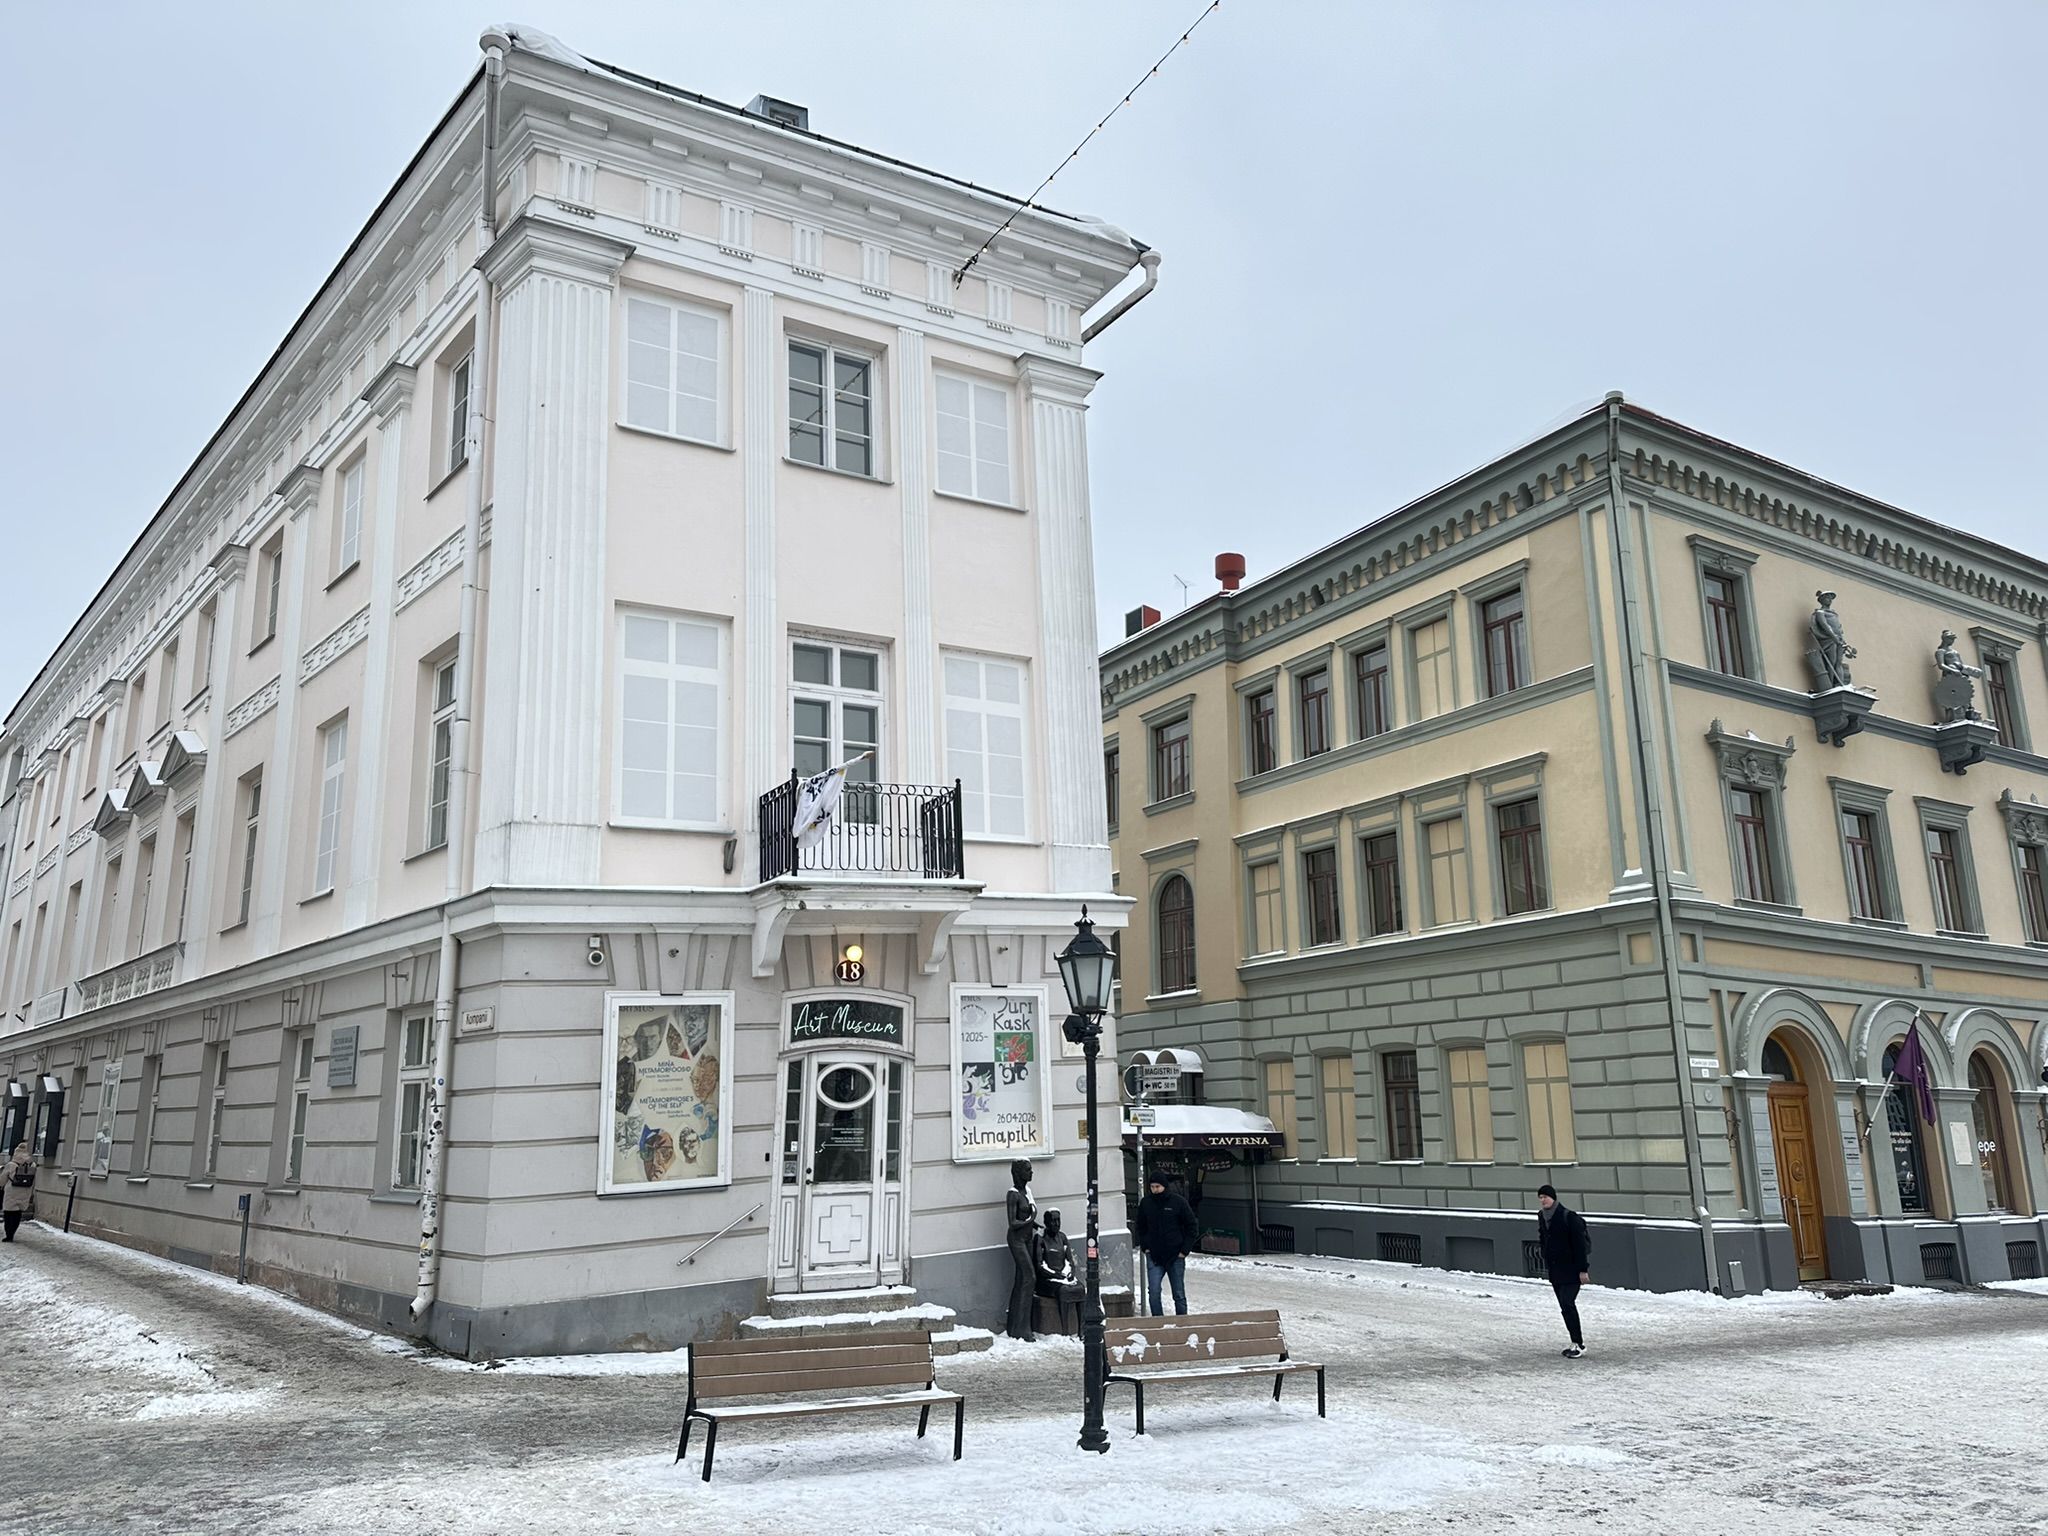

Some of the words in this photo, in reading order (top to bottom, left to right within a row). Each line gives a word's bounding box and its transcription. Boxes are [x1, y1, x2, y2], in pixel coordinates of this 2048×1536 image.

[840, 962, 861, 980] 18
[794, 1003, 828, 1036] Art
[831, 1003, 897, 1035] Museum
[993, 1013, 1031, 1031] Kask
[1144, 1067, 1172, 1076] MAGISTRI
[648, 1103, 656, 1111] OF
[1208, 1137, 1270, 1146] TAVERNA
